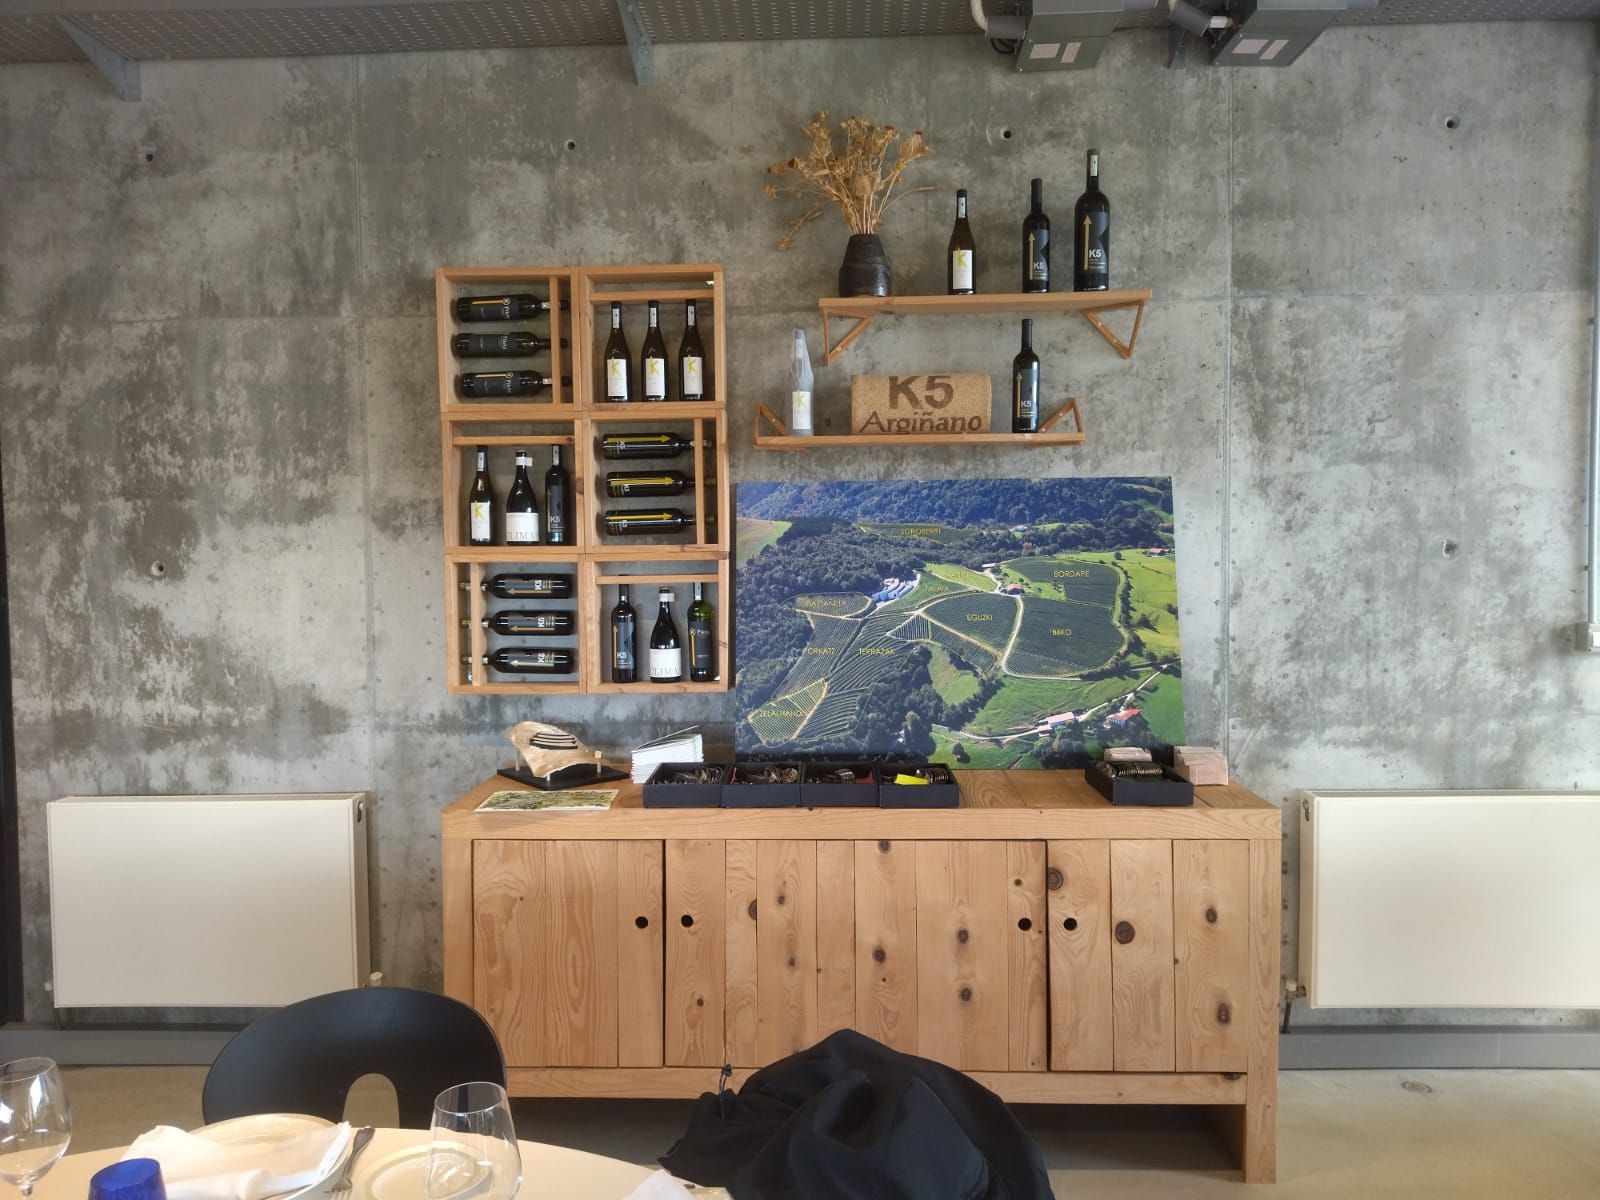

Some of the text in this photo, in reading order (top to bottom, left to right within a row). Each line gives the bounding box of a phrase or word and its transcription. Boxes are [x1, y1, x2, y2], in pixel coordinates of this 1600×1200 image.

[1089, 249, 1102, 258] K5
[1033, 262, 1045, 270] K5
[888, 375, 954, 410] K5
[1020, 400, 1032, 408] K5
[859, 410, 983, 435] Argiñano
[550, 515, 561, 523] K5
[616, 651, 628, 659] K5
